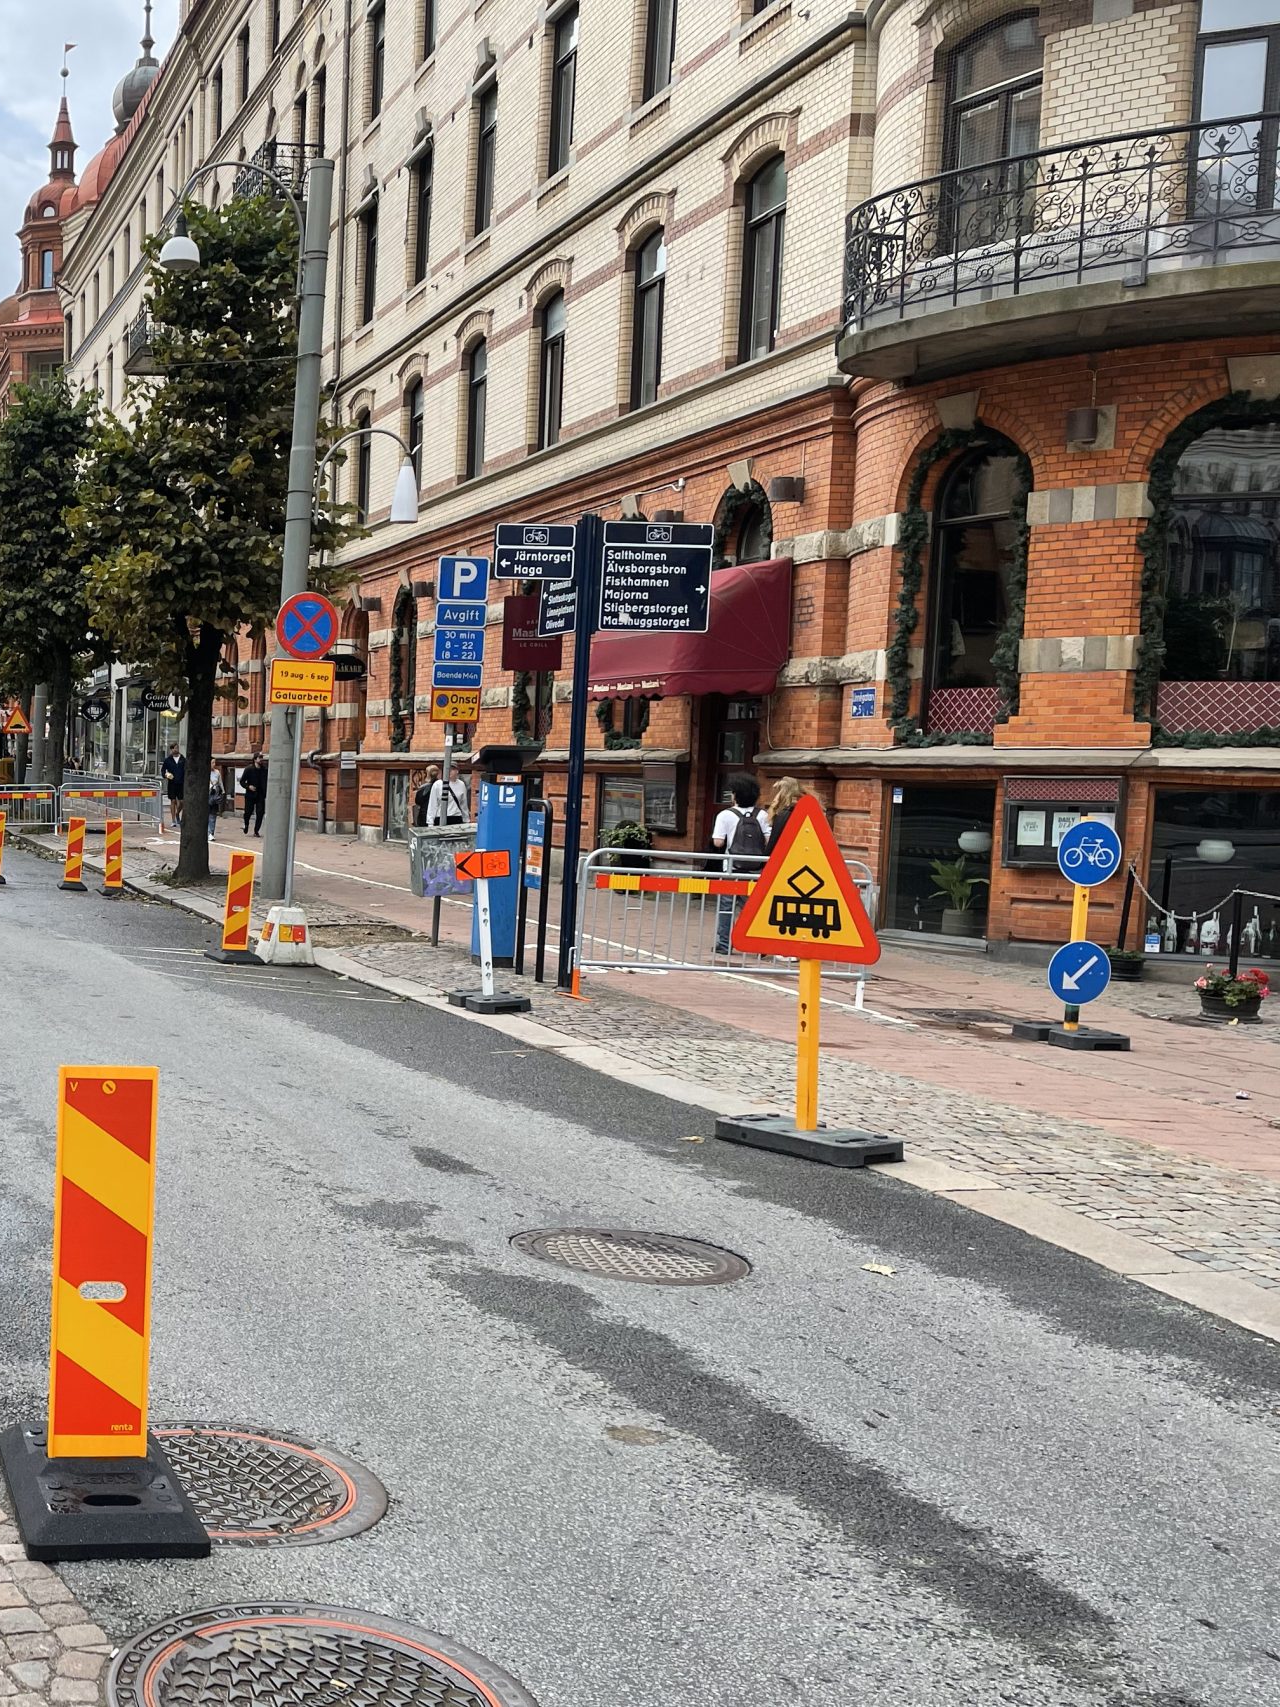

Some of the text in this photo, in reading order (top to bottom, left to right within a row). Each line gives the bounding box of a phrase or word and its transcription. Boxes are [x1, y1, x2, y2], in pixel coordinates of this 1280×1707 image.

[514, 550, 571, 564] Järntorget
[607, 549, 667, 561] Saltholmen
[513, 564, 543, 577] Haga
[606, 560, 687, 576] Älvsborgsbron
[452, 561, 478, 597] P
[605, 576, 670, 587] Fiskhamnen
[604, 589, 649, 601] Majorna
[603, 602, 689, 616] Stigbergstorget
[443, 608, 480, 623] Avgift
[602, 615, 690, 629] Mahuggstorget
[444, 631, 476, 640] 30 min
[445, 641, 452, 649] 8
[462, 642, 474, 650] 22
[441, 651, 451, 660] (8
[461, 651, 477, 660] 22)
[336, 662, 362, 673] LÄKARE
[280, 670, 289, 678] 19
[436, 671, 462, 679] Boende
[275, 691, 328, 702] Gatuarbete
[450, 694, 478, 704] Onsd
[451, 707, 459, 717] 2
[468, 707, 475, 717] 7
[69, 1081, 79, 1092] V
[110, 1423, 134, 1432] renta
